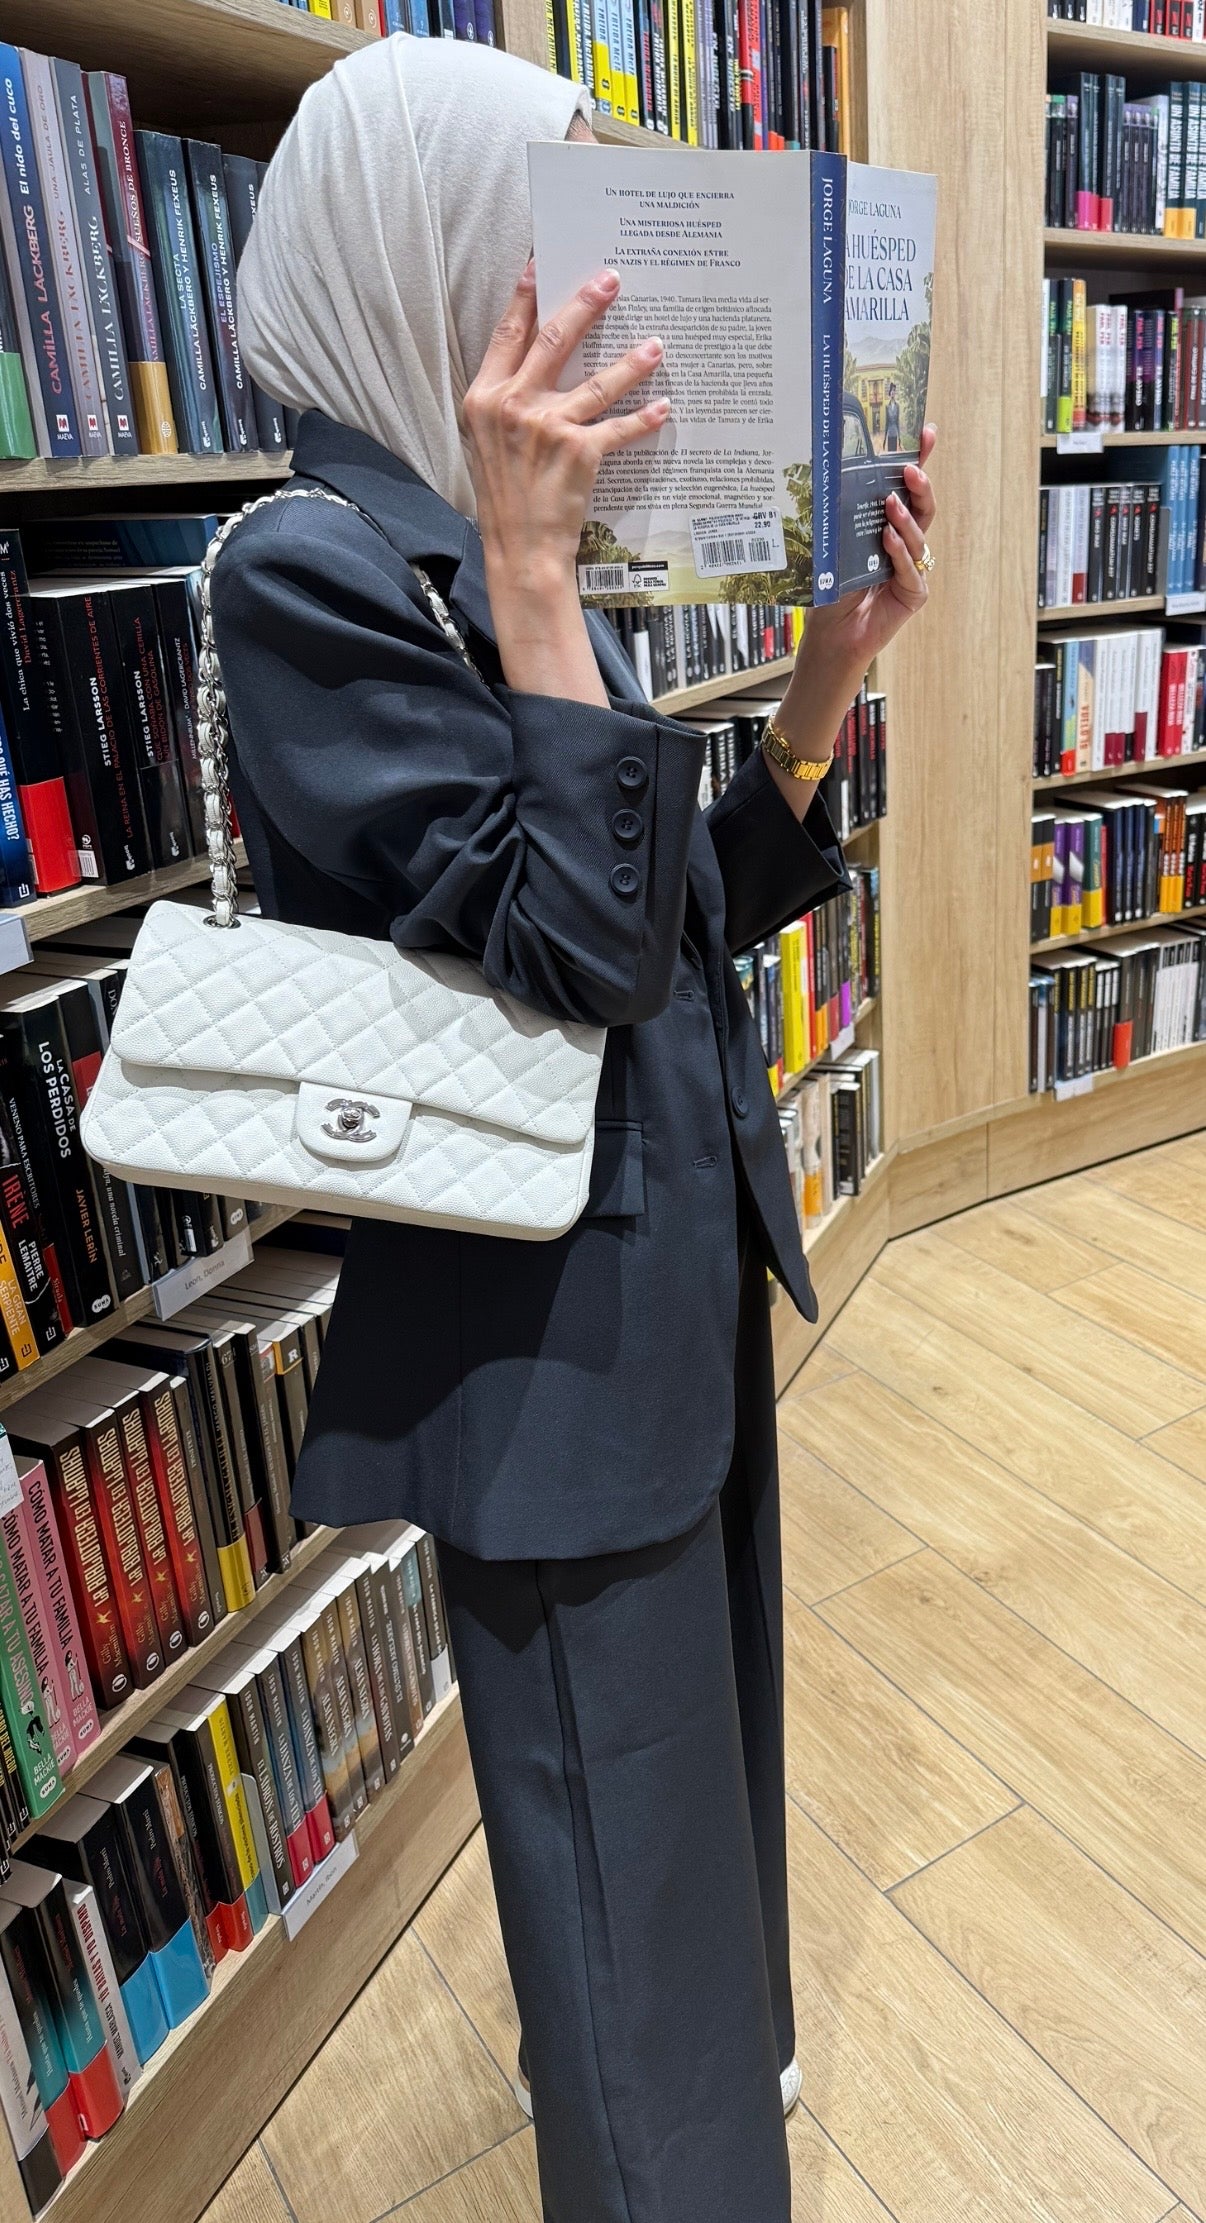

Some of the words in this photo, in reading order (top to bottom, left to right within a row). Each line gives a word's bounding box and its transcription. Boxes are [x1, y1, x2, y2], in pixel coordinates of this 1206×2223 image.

[4, 78, 17, 114] cuco
[9, 117, 21, 141] del
[70, 95, 82, 135] PLATA
[78, 140, 85, 157] DE
[119, 121, 132, 172] BRONCE
[14, 145, 29, 178] nido
[20, 181, 30, 195] El
[82, 163, 91, 195] ALAS
[126, 175, 136, 191] DE
[168, 169, 182, 216] FEXEUS
[646, 190, 656, 198] DE
[656, 200, 700, 209] MALDICIÓN
[821, 177, 834, 232] JORGE
[129, 193, 144, 244] SUEÑOS
[619, 217, 637, 227] UNA
[637, 220, 684, 228] MISTERIOSA
[869, 201, 902, 219] LAGUNA
[174, 218, 188, 263] HENRIK
[620, 230, 653, 238] LLEGADA
[655, 230, 681, 238] DESDE
[852, 228, 917, 262] HUÉSPED
[615, 247, 625, 255] LA
[620, 258, 642, 266] NAZIS
[661, 258, 695, 267] RÉGIMEN
[172, 253, 186, 294] SECTA
[183, 265, 190, 273] Y
[210, 242, 225, 308] ESPEJISMO
[823, 236, 833, 304] LAGUNA
[858, 266, 874, 290] LA
[877, 266, 913, 292] CASA
[179, 296, 187, 310] LA
[220, 309, 228, 323] EL
[845, 297, 910, 321] AMARILLA
[823, 334, 831, 351] LA
[104, 322, 124, 401] CAMILLA
[191, 340, 207, 391] CAMILLA
[822, 354, 832, 416] HUÉSPED
[822, 420, 830, 438] DE
[822, 441, 830, 457] LA
[822, 460, 830, 492] CASA
[0, 571, 9, 600] veces
[5, 600, 13, 619] dos
[84, 596, 94, 618] AIRE
[9, 620, 18, 647] vivió
[89, 620, 97, 633] DE
[13, 648, 24, 668] que
[21, 638, 32, 665] David
[91, 635, 108, 694] CORRIENTES
[18, 669, 28, 696] chica
[133, 670, 149, 723] LARSSON
[22, 698, 30, 711] La
[89, 677, 106, 731] LARSSON
[101, 696, 111, 716] LAS
[106, 716, 114, 728] DE
[99, 734, 112, 767] STIEG
[107, 730, 121, 769] PALACIO
[143, 725, 154, 757] STIEG
[116, 770, 124, 782] EL
[118, 783, 126, 796] EN
[1, 803, 20, 841] HECHO?
[120, 798, 131, 825] REINA
[126, 826, 134, 838] LA
[38, 1041, 55, 1074] LOS
[56, 1058, 65, 1073] LA
[59, 1073, 75, 1117] CASA
[9, 1097, 22, 1134] VENENO
[45, 1078, 72, 1159] PERDIDOS
[68, 1117, 77, 1132] DE
[18, 1135, 28, 1159] PARA
[22, 1158, 41, 1209] ESCRITORES
[76, 1188, 90, 1228] JAVIER
[84, 1228, 98, 1264] LERÍN
[113, 1225, 127, 1257] criminal
[17, 1239, 39, 1293] LEMAITRE
[28, 1240, 45, 1280] PIERRE
[0, 1279, 21, 1336] SERPIENTE
[7, 1279, 16, 1290] LA
[12, 1291, 27, 1326] GRAN
[28, 1480, 42, 1524] CÓMO
[36, 1523, 57, 1570] MATAR
[45, 1568, 56, 1582] A
[49, 1575, 62, 1599] TU
[52, 1597, 74, 1651] FAMILIA
[33, 1753, 52, 1775] BELLA
[33, 1762, 56, 1786] MACKIE
[77, 1903, 91, 1942] DISPARO
